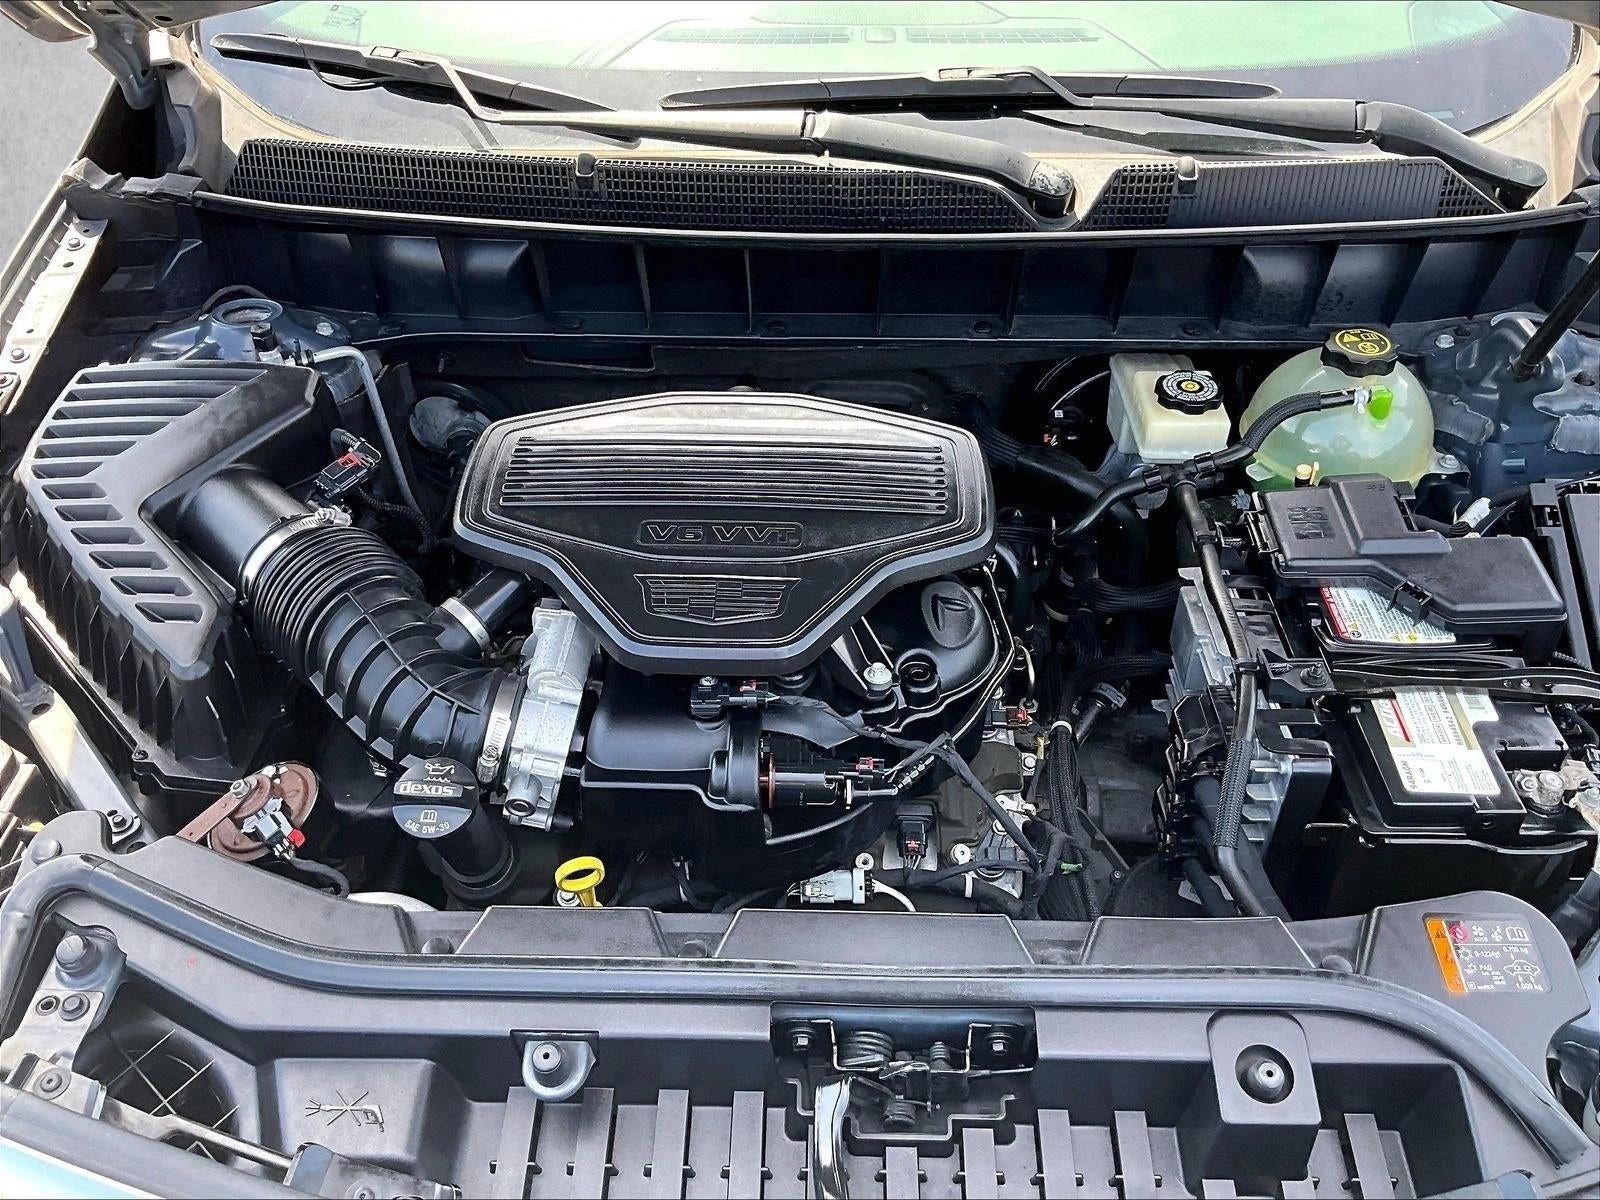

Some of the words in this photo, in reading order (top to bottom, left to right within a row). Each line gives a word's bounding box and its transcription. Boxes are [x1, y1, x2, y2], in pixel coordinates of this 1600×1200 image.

[646, 524, 703, 542] V6
[712, 525, 796, 543] VVT
[399, 781, 457, 796] dexos
[404, 819, 420, 832] SAE
[422, 821, 450, 834] 5W-30
